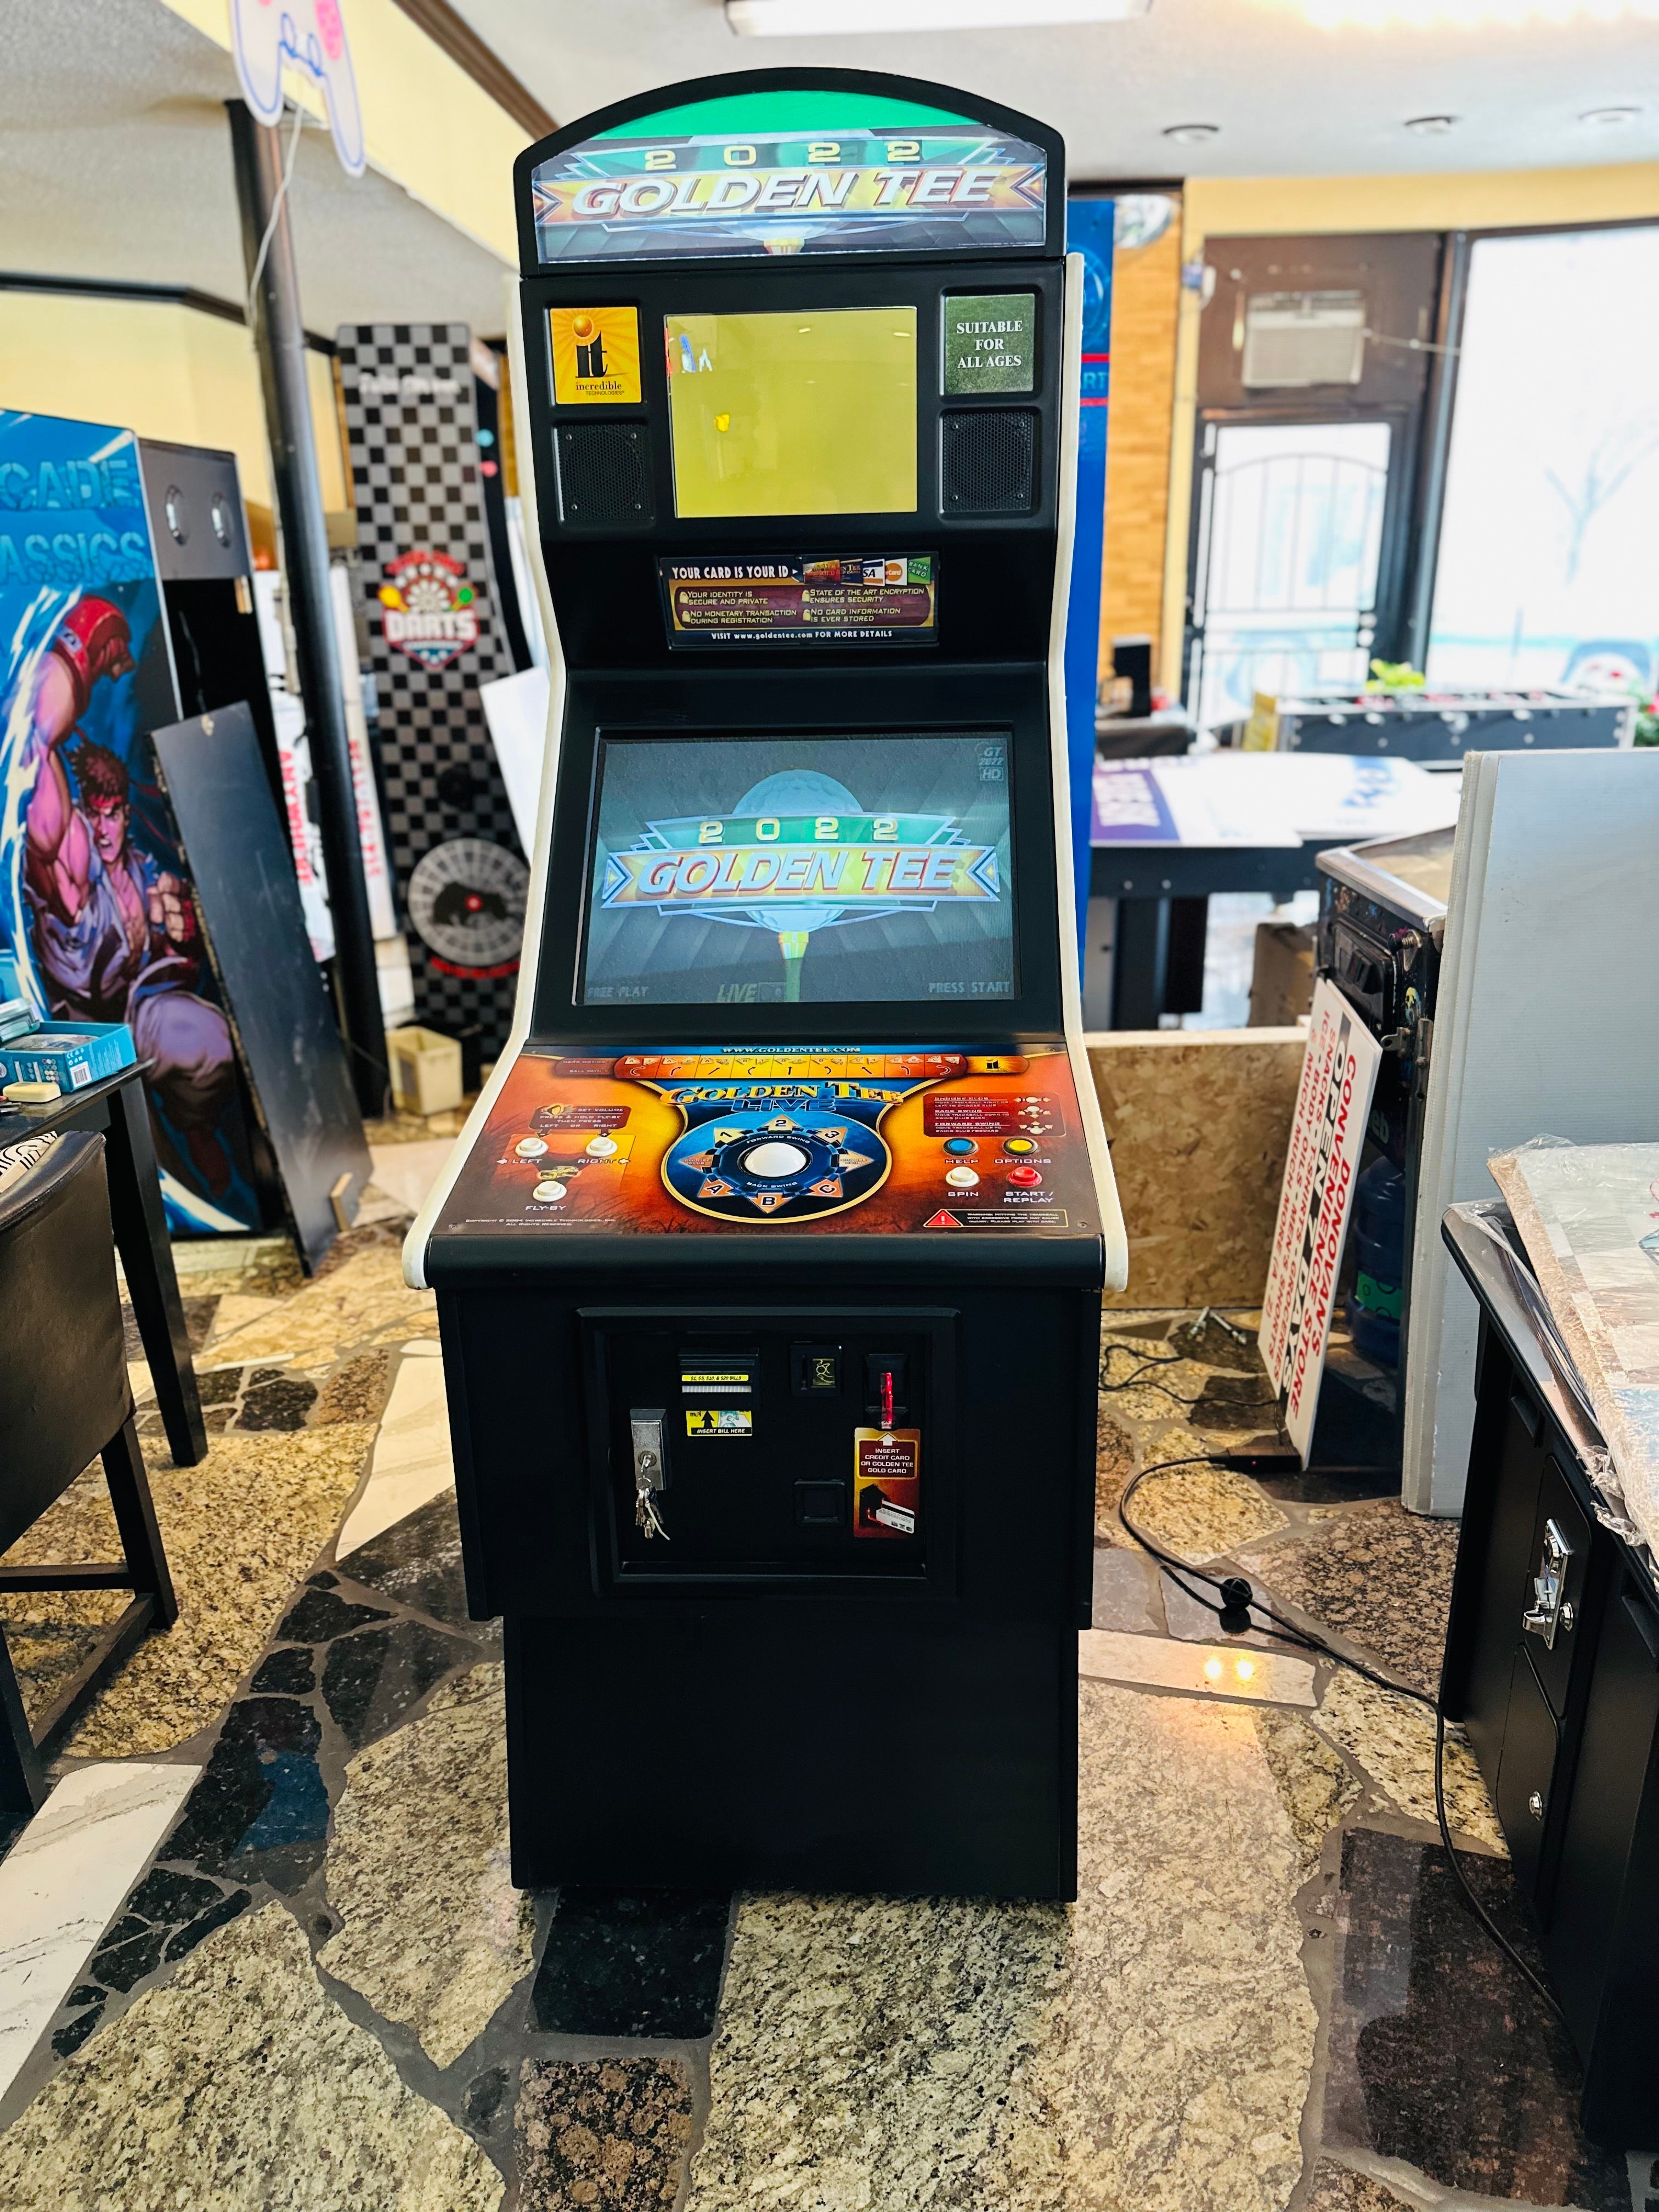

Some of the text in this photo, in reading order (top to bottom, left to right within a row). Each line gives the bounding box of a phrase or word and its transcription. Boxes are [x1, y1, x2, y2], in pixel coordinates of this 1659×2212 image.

[573, 170, 1001, 215] GOLDEN TEE
[956, 320, 1023, 334] SUITABLE
[573, 315, 608, 378] it
[975, 338, 1005, 351] FOR
[957, 356, 1022, 368] ALL AGES
[576, 381, 622, 390] incredible
[0, 460, 131, 510] CADE
[0, 532, 147, 584] ASSICS
[672, 567, 701, 579] YOUR
[704, 567, 731, 579] CARD
[734, 566, 742, 578] IS
[747, 566, 775, 578] YOUR
[778, 565, 788, 577] ID
[863, 569, 876, 578] SA
[908, 567, 927, 578] CARD
[909, 561, 928, 572] BANK
[385, 608, 477, 642] DARTS
[734, 632, 812, 640] www.goldentee.com
[983, 769, 1002, 778] HD
[639, 851, 961, 894] GOLDEN TEE
[716, 984, 758, 1002] LIVE
[929, 981, 1010, 993] PRESS START
[1299, 1051, 1313, 1119] MUCH
[660, 1081, 904, 1105] GOLDEN TEE
[731, 1098, 837, 1113] LIVE
[775, 1119, 787, 1127] 2
[746, 1135, 785, 1144] FORWARD
[825, 1130, 840, 1139] 3
[1286, 1123, 1301, 1190] MUCH
[706, 1183, 724, 1194] A
[819, 1184, 836, 1194] C
[1268, 1011, 1330, 1359] ICE BODY OILS MEN'S SHORTS
[762, 1197, 776, 1205] B
[1274, 1028, 1336, 1382] SNACKS T-SHIRTS GROCERIES
[1283, 1041, 1346, 1393] OPEN 7 DAYS
[1276, 1195, 1290, 1256] MORE
[1290, 1054, 1356, 1420] CONVENIENCE STORE
[1312, 1156, 1351, 1358] DONOVAN'S
